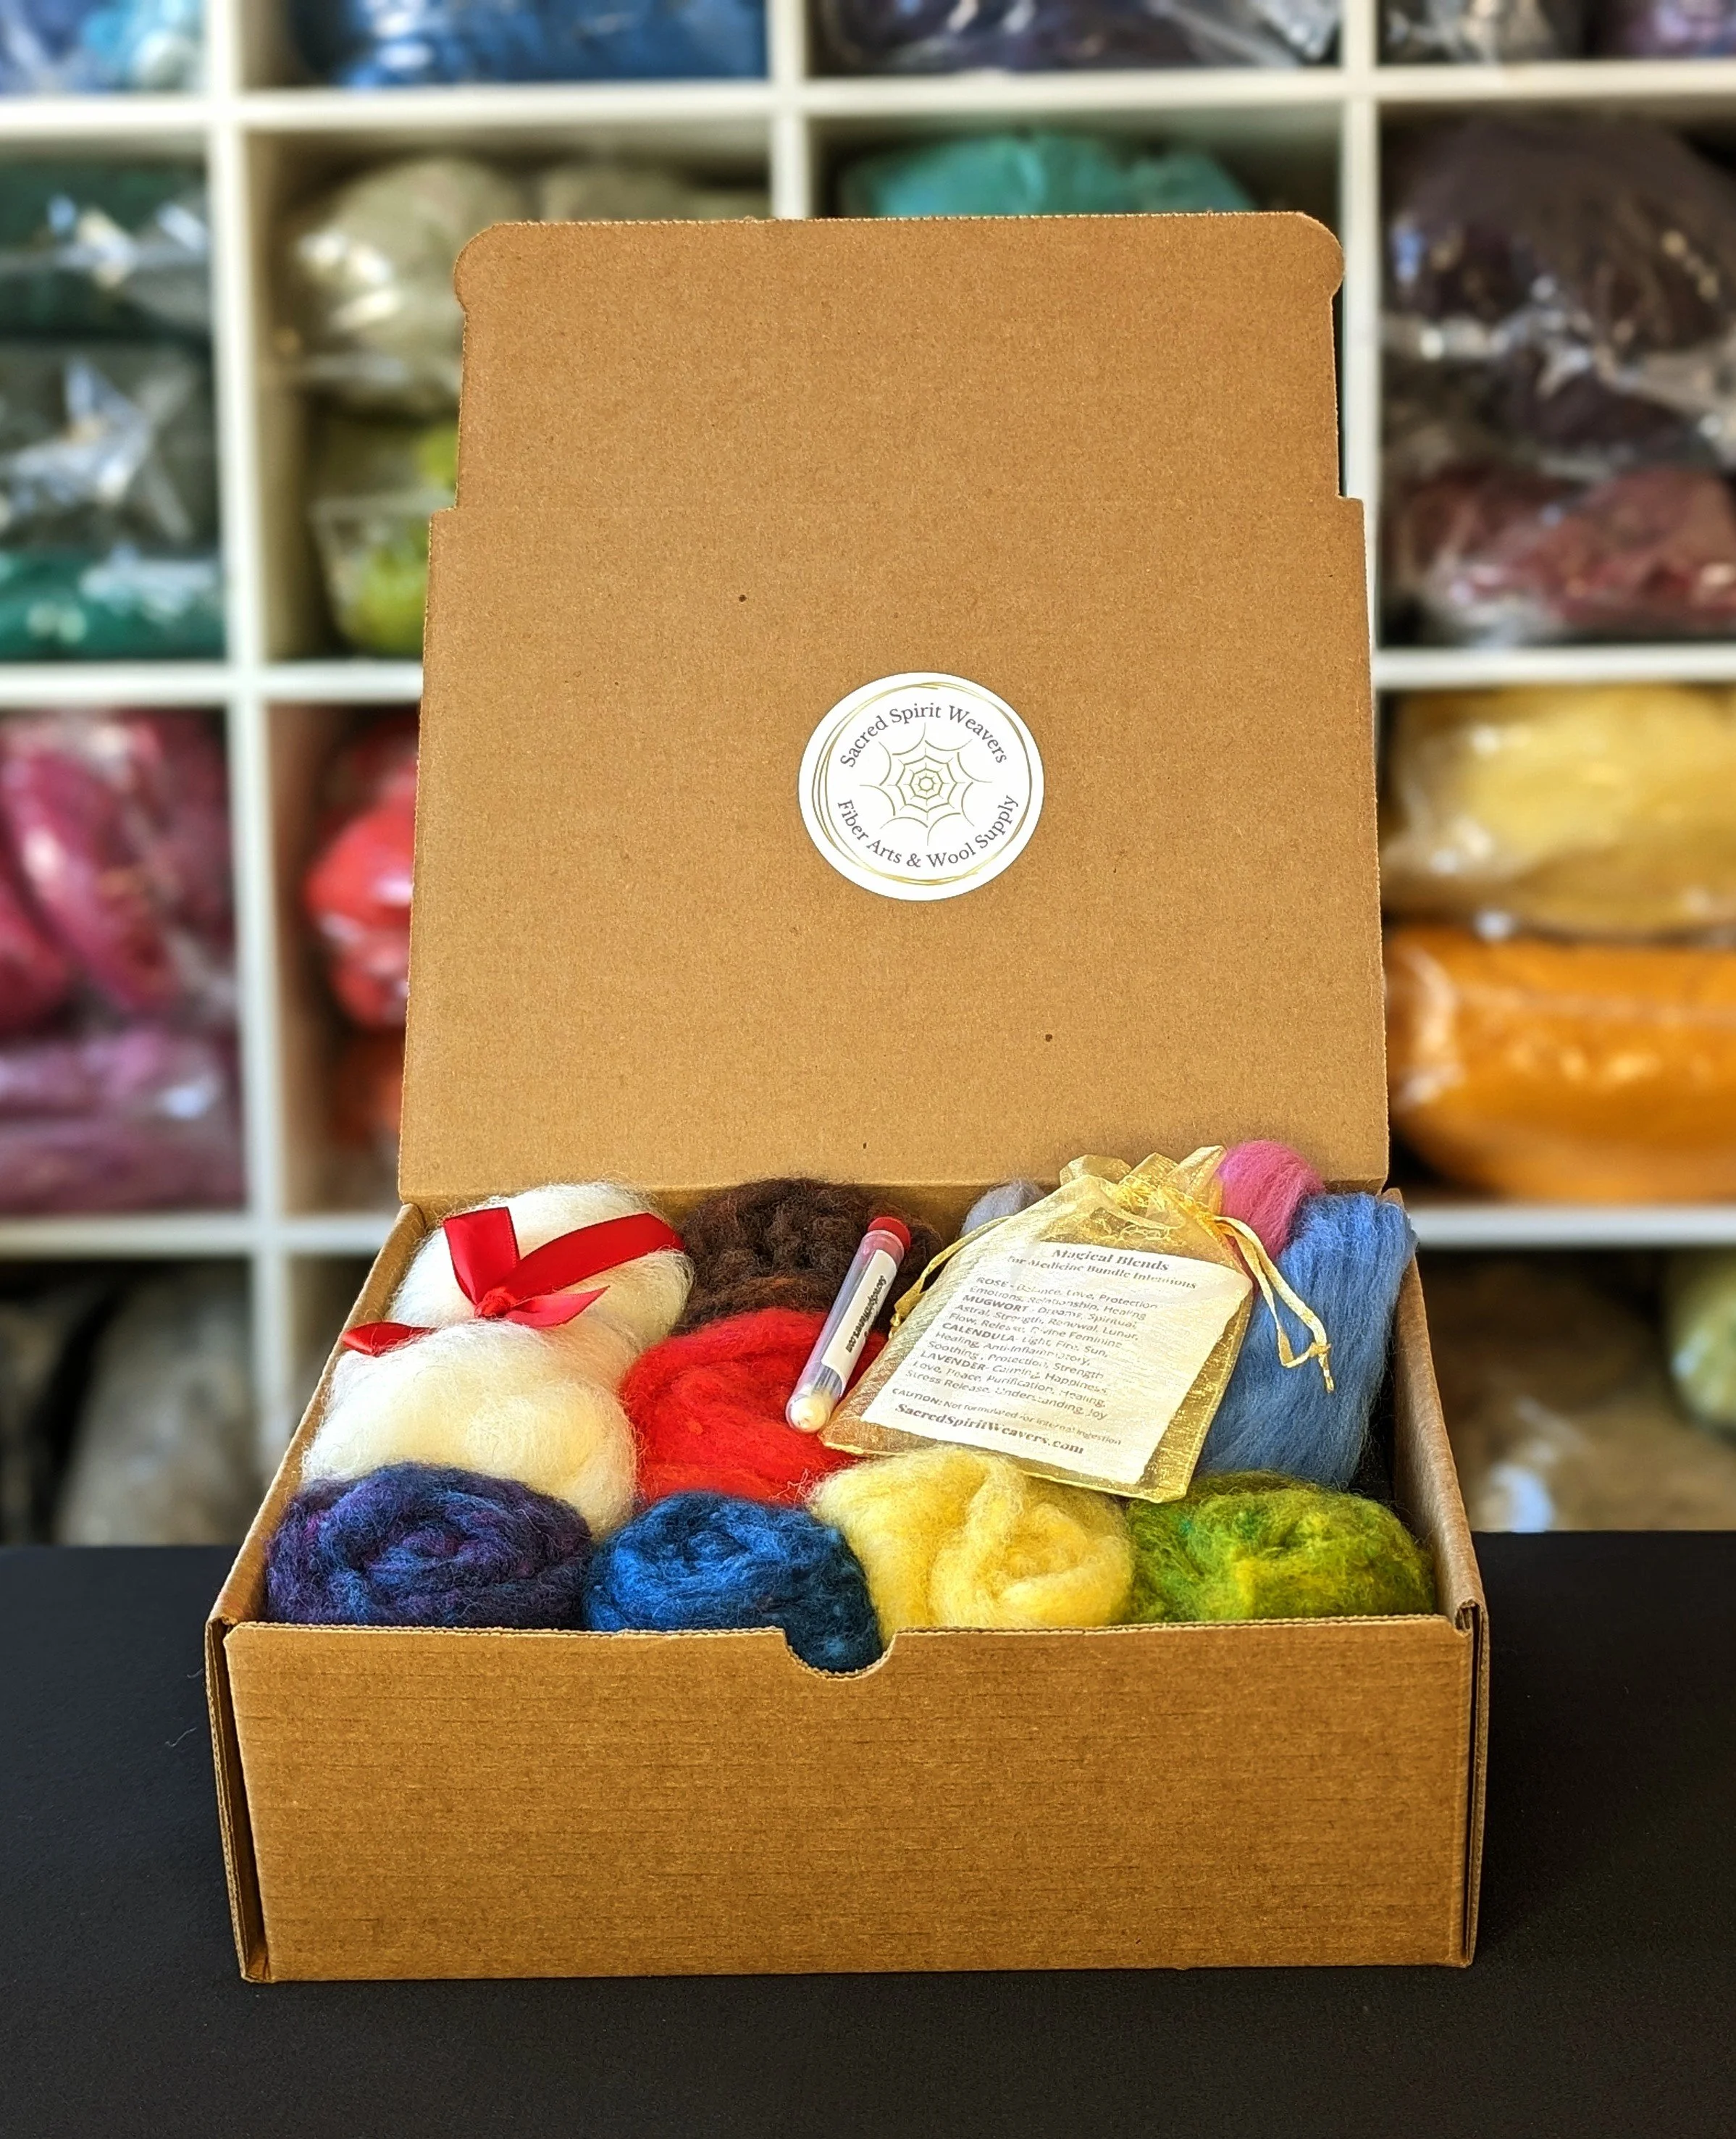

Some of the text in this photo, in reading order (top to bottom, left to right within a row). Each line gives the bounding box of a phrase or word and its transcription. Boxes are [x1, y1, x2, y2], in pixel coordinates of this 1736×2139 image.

[839, 702, 1008, 768] Sacred Spirit Weavers
[837, 794, 1020, 868] Fiber Arts & Wool Supply
[1028, 1259, 1084, 1272] Medicine
[1087, 1265, 1131, 1279] Bundle
[1052, 1249, 1170, 1272] Magical Blends
[962, 1294, 1030, 1312] MUGWORT
[894, 1403, 1086, 1454] SacredSpiritWeavers.com
